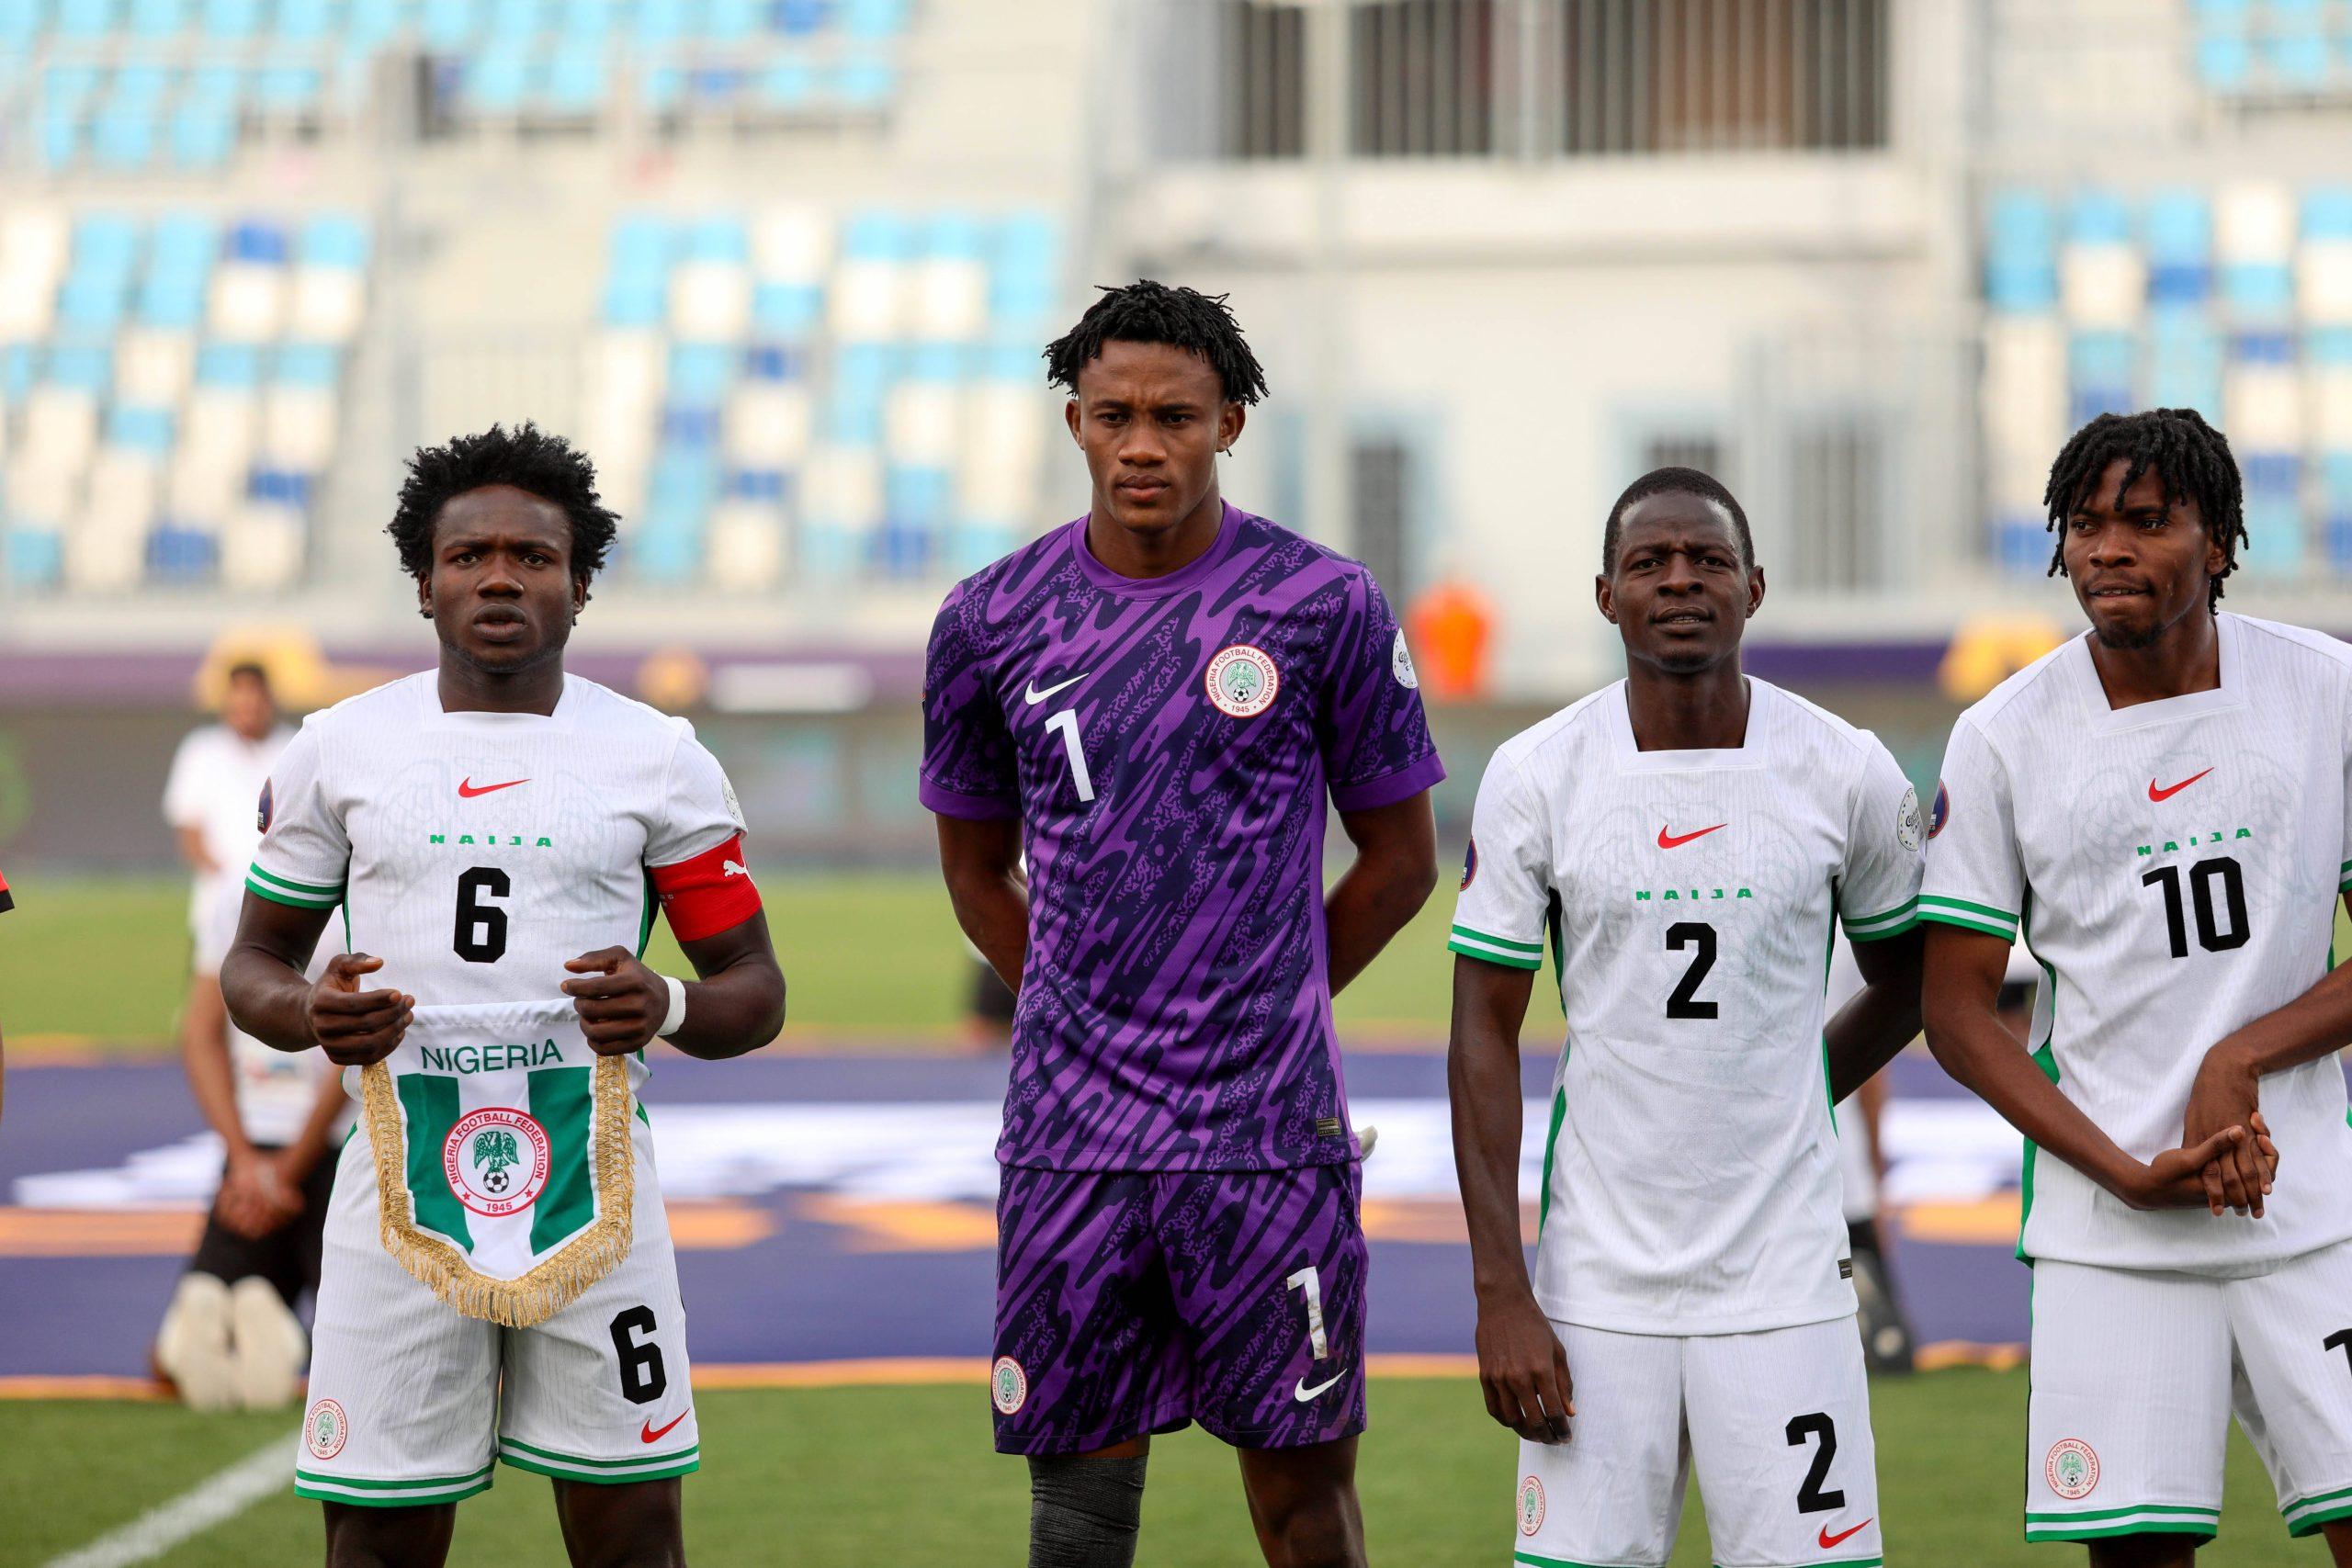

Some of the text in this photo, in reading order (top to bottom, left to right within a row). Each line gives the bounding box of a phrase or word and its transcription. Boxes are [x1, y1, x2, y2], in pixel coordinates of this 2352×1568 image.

[1209, 649, 1274, 705] NIGERIA FOOTBALL FEDERATION
[1231, 705, 1250, 713] 1945
[1045, 708, 1095, 802] 1
[429, 834, 552, 847] NAIJA
[2136, 828, 2252, 856] NAIJA
[453, 866, 511, 964] 6
[1635, 888, 1753, 901] NAIJA
[2142, 856, 2251, 959] 10
[1666, 922, 1718, 1020] 2
[420, 1038, 564, 1075] NIGERIA
[447, 1112, 546, 1185] NIGERIA FOOTBALL FEDERATION
[486, 1201, 513, 1213] 1945
[1286, 1265, 1328, 1360] 1
[609, 1304, 667, 1404] 6
[1012, 1365, 1024, 1405] FEDERATION
[311, 1402, 335, 1416] FOOTBALL
[334, 1408, 345, 1450] FEDERATION
[1785, 1412, 1845, 1514] 2
[2048, 1442, 2096, 1488] NIGERIA FOOTBALL FEDERATION
